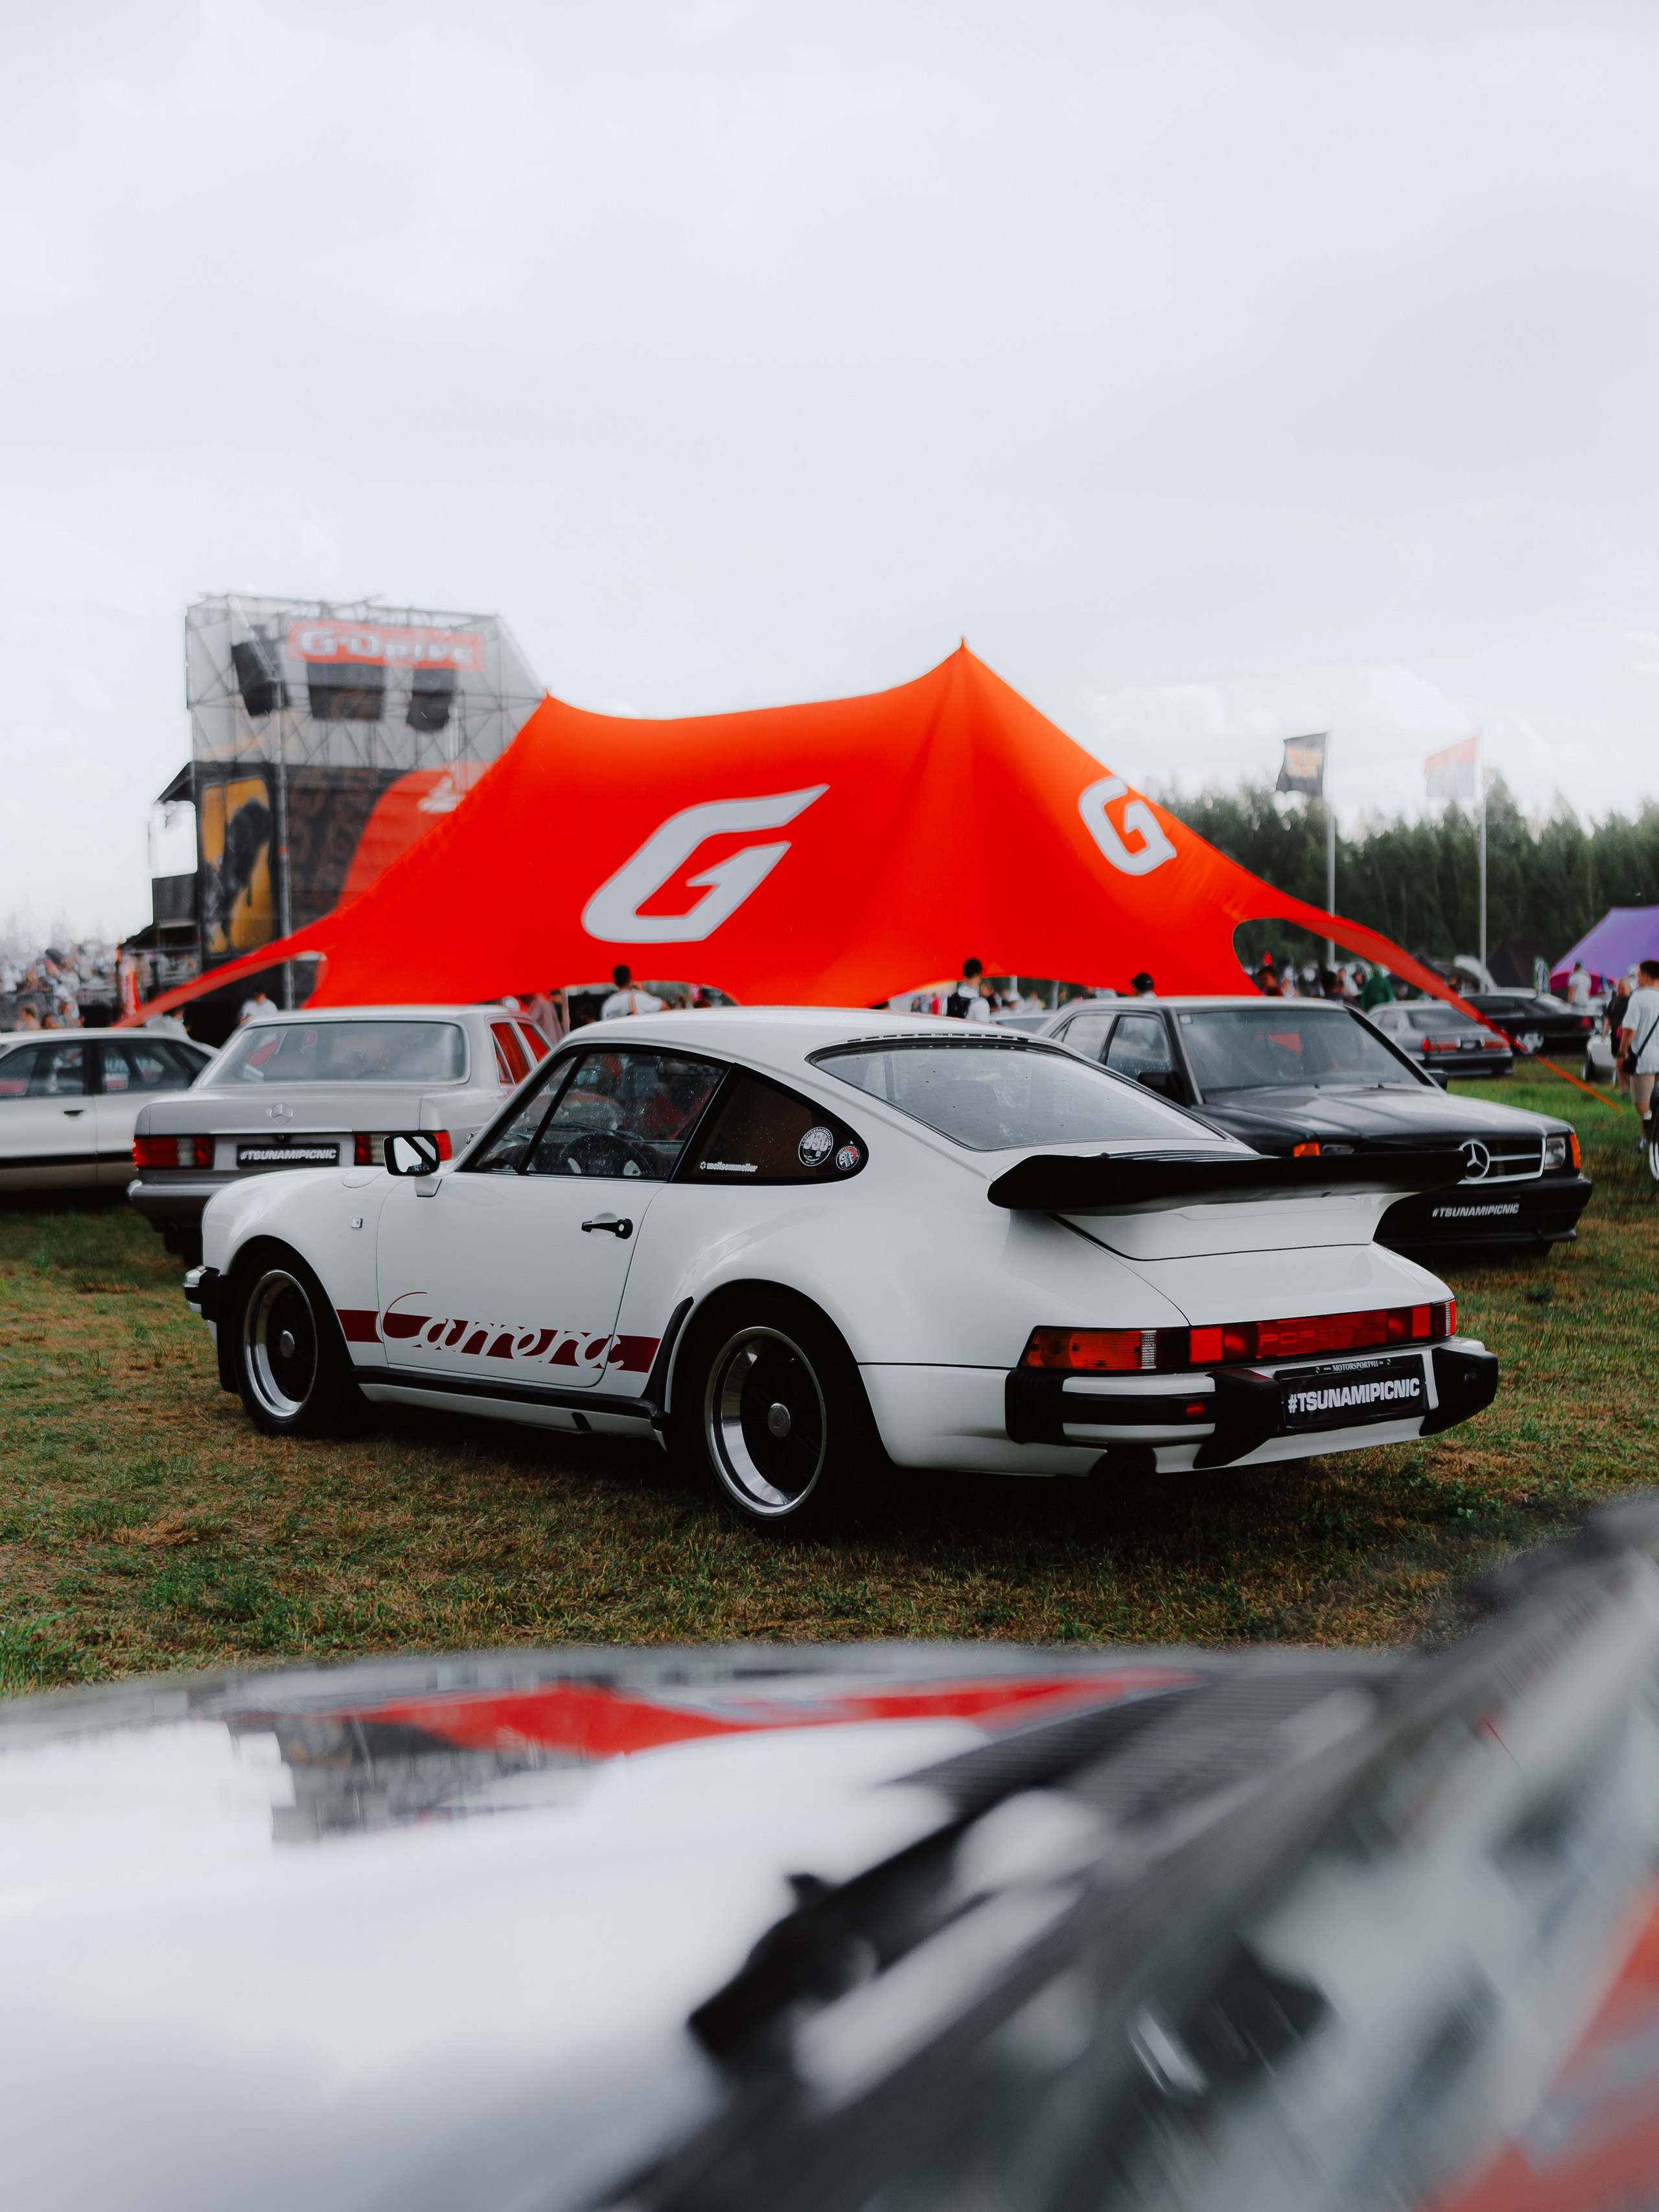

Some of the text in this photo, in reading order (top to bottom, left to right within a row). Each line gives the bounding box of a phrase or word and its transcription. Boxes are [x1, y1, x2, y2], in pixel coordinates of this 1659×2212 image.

[1078, 775, 1177, 876] G
[581, 783, 831, 944] G
[240, 1149, 337, 1160] #TSUNAMIPICNIC
[1432, 1203, 1520, 1218] #TSUNAMIPICNIC
[377, 1291, 624, 1370] Carrera
[1288, 1378, 1420, 1414] #TSUNAMIPICNIC
